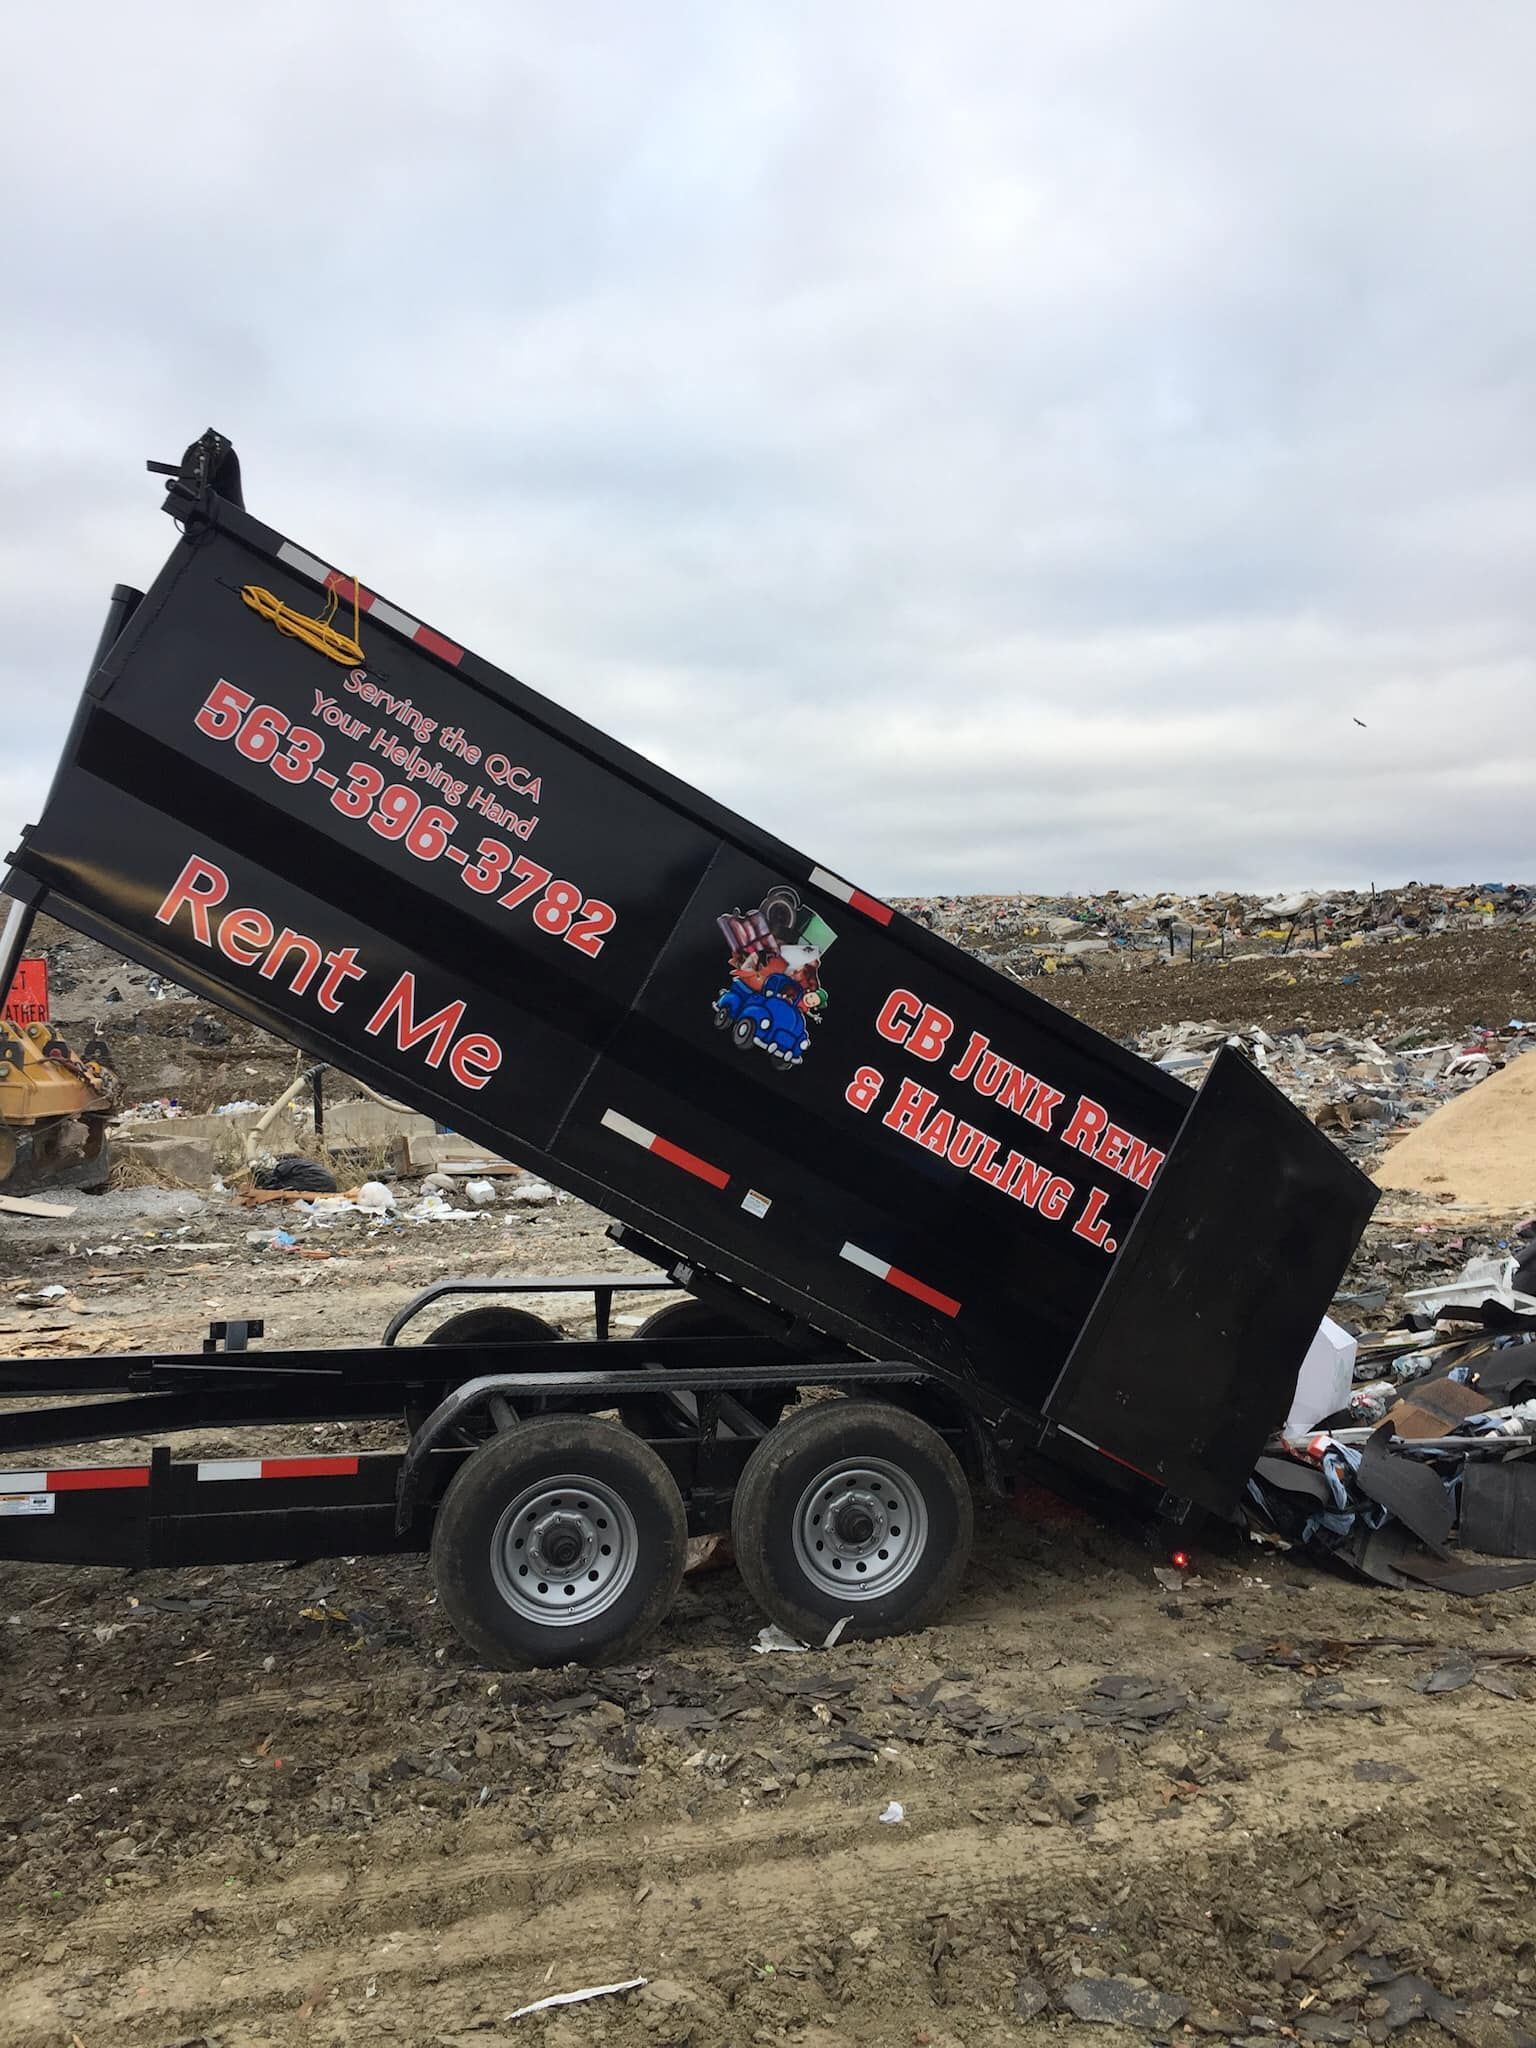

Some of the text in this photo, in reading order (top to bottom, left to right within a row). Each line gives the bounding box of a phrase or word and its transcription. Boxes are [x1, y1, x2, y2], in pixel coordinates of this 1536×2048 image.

[194, 678, 617, 958] 563-396-3782
[311, 688, 540, 842] Your Helping Hand
[343, 669, 543, 804] Serving the QCA
[155, 855, 503, 1090] Rent Me
[845, 1065, 1118, 1254] & HAULING L.
[875, 988, 1166, 1190] CB JUNK REM
